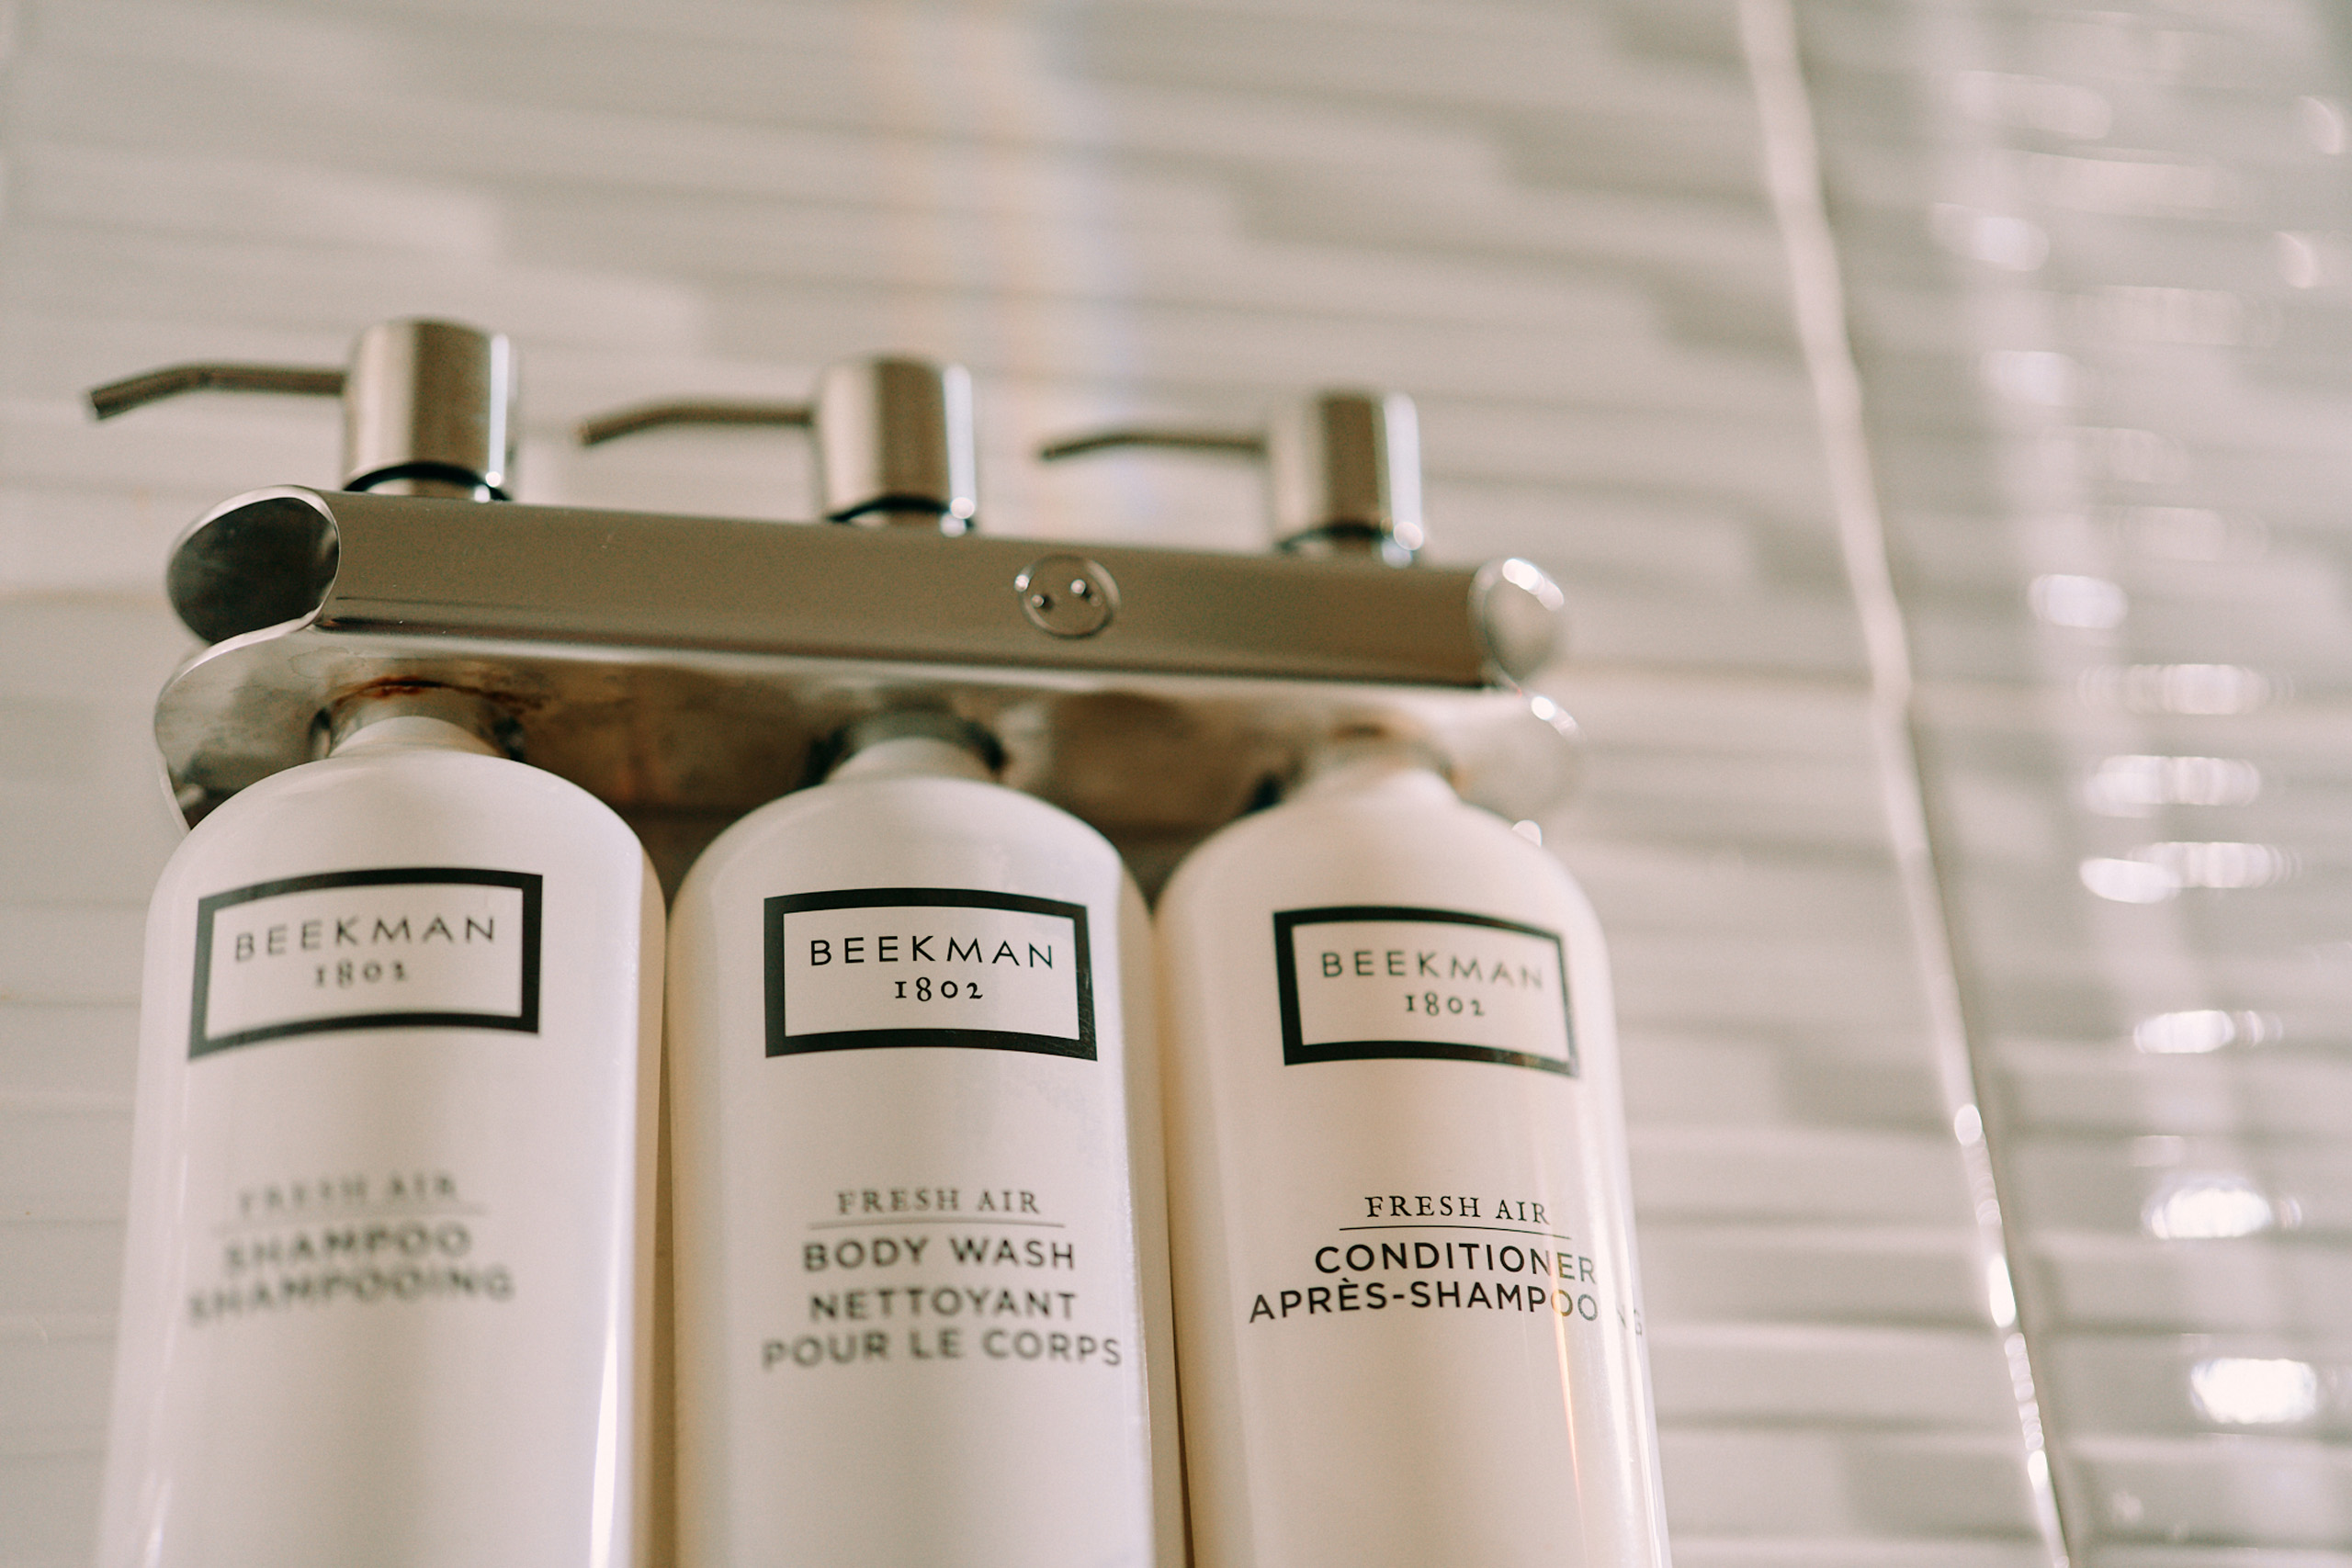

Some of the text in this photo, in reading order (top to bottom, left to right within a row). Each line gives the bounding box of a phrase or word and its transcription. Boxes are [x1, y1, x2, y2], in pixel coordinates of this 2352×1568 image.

[234, 914, 496, 964] BEEKMAN
[809, 934, 1055, 970] BEEKMAN
[1321, 950, 1544, 989] BEEKMAN
[894, 976, 983, 1002] 1802
[1405, 992, 1485, 1017] 1802
[835, 1188, 1041, 1215] FRESH AIR
[1364, 1195, 1552, 1225] FRESH AIR
[223, 1220, 474, 1277] SHAMPOO
[802, 1236, 1075, 1272] BODY WASH
[1315, 1242, 1599, 1285] CONDITIONER
[808, 1290, 1079, 1324] NETTOYANT
[761, 1329, 1123, 1372] POUR LE CORPS
